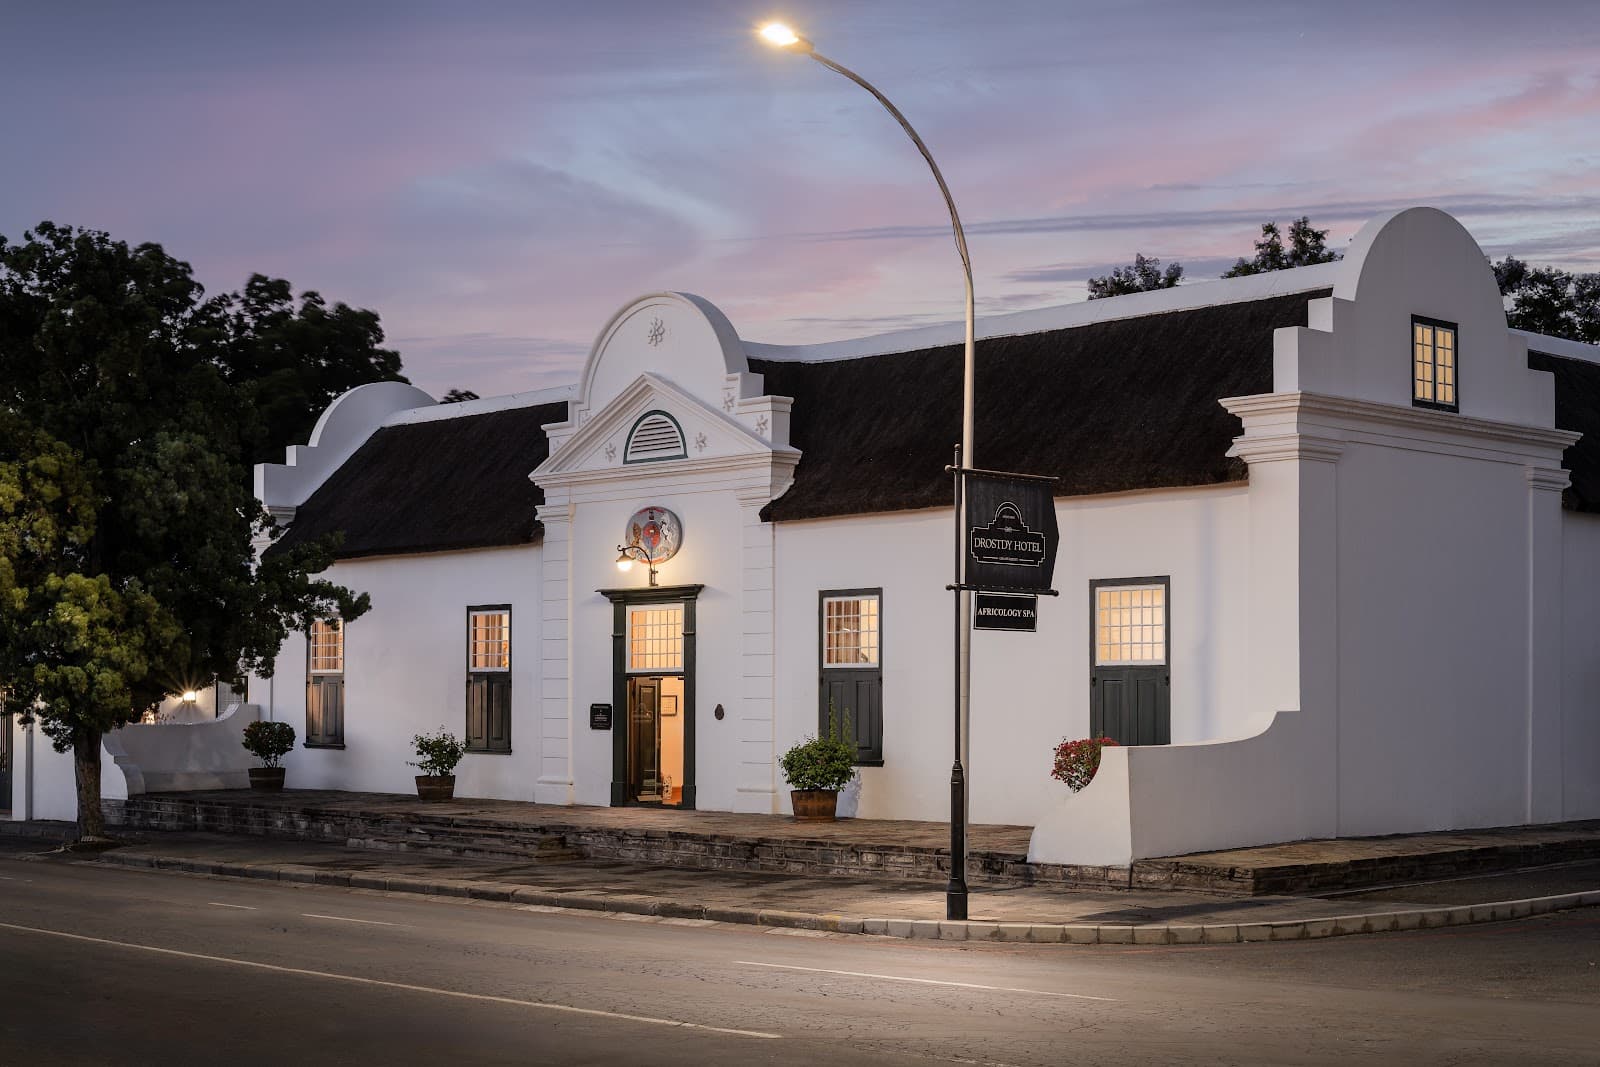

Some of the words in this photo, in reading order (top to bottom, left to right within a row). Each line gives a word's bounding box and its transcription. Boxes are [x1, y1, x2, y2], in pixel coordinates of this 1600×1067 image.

[974, 537, 1012, 551] DROSTDY
[1014, 541, 1042, 552] HOTEL
[977, 607, 1022, 617] AFRICOLOGY
[1022, 609, 1035, 618] SPA
